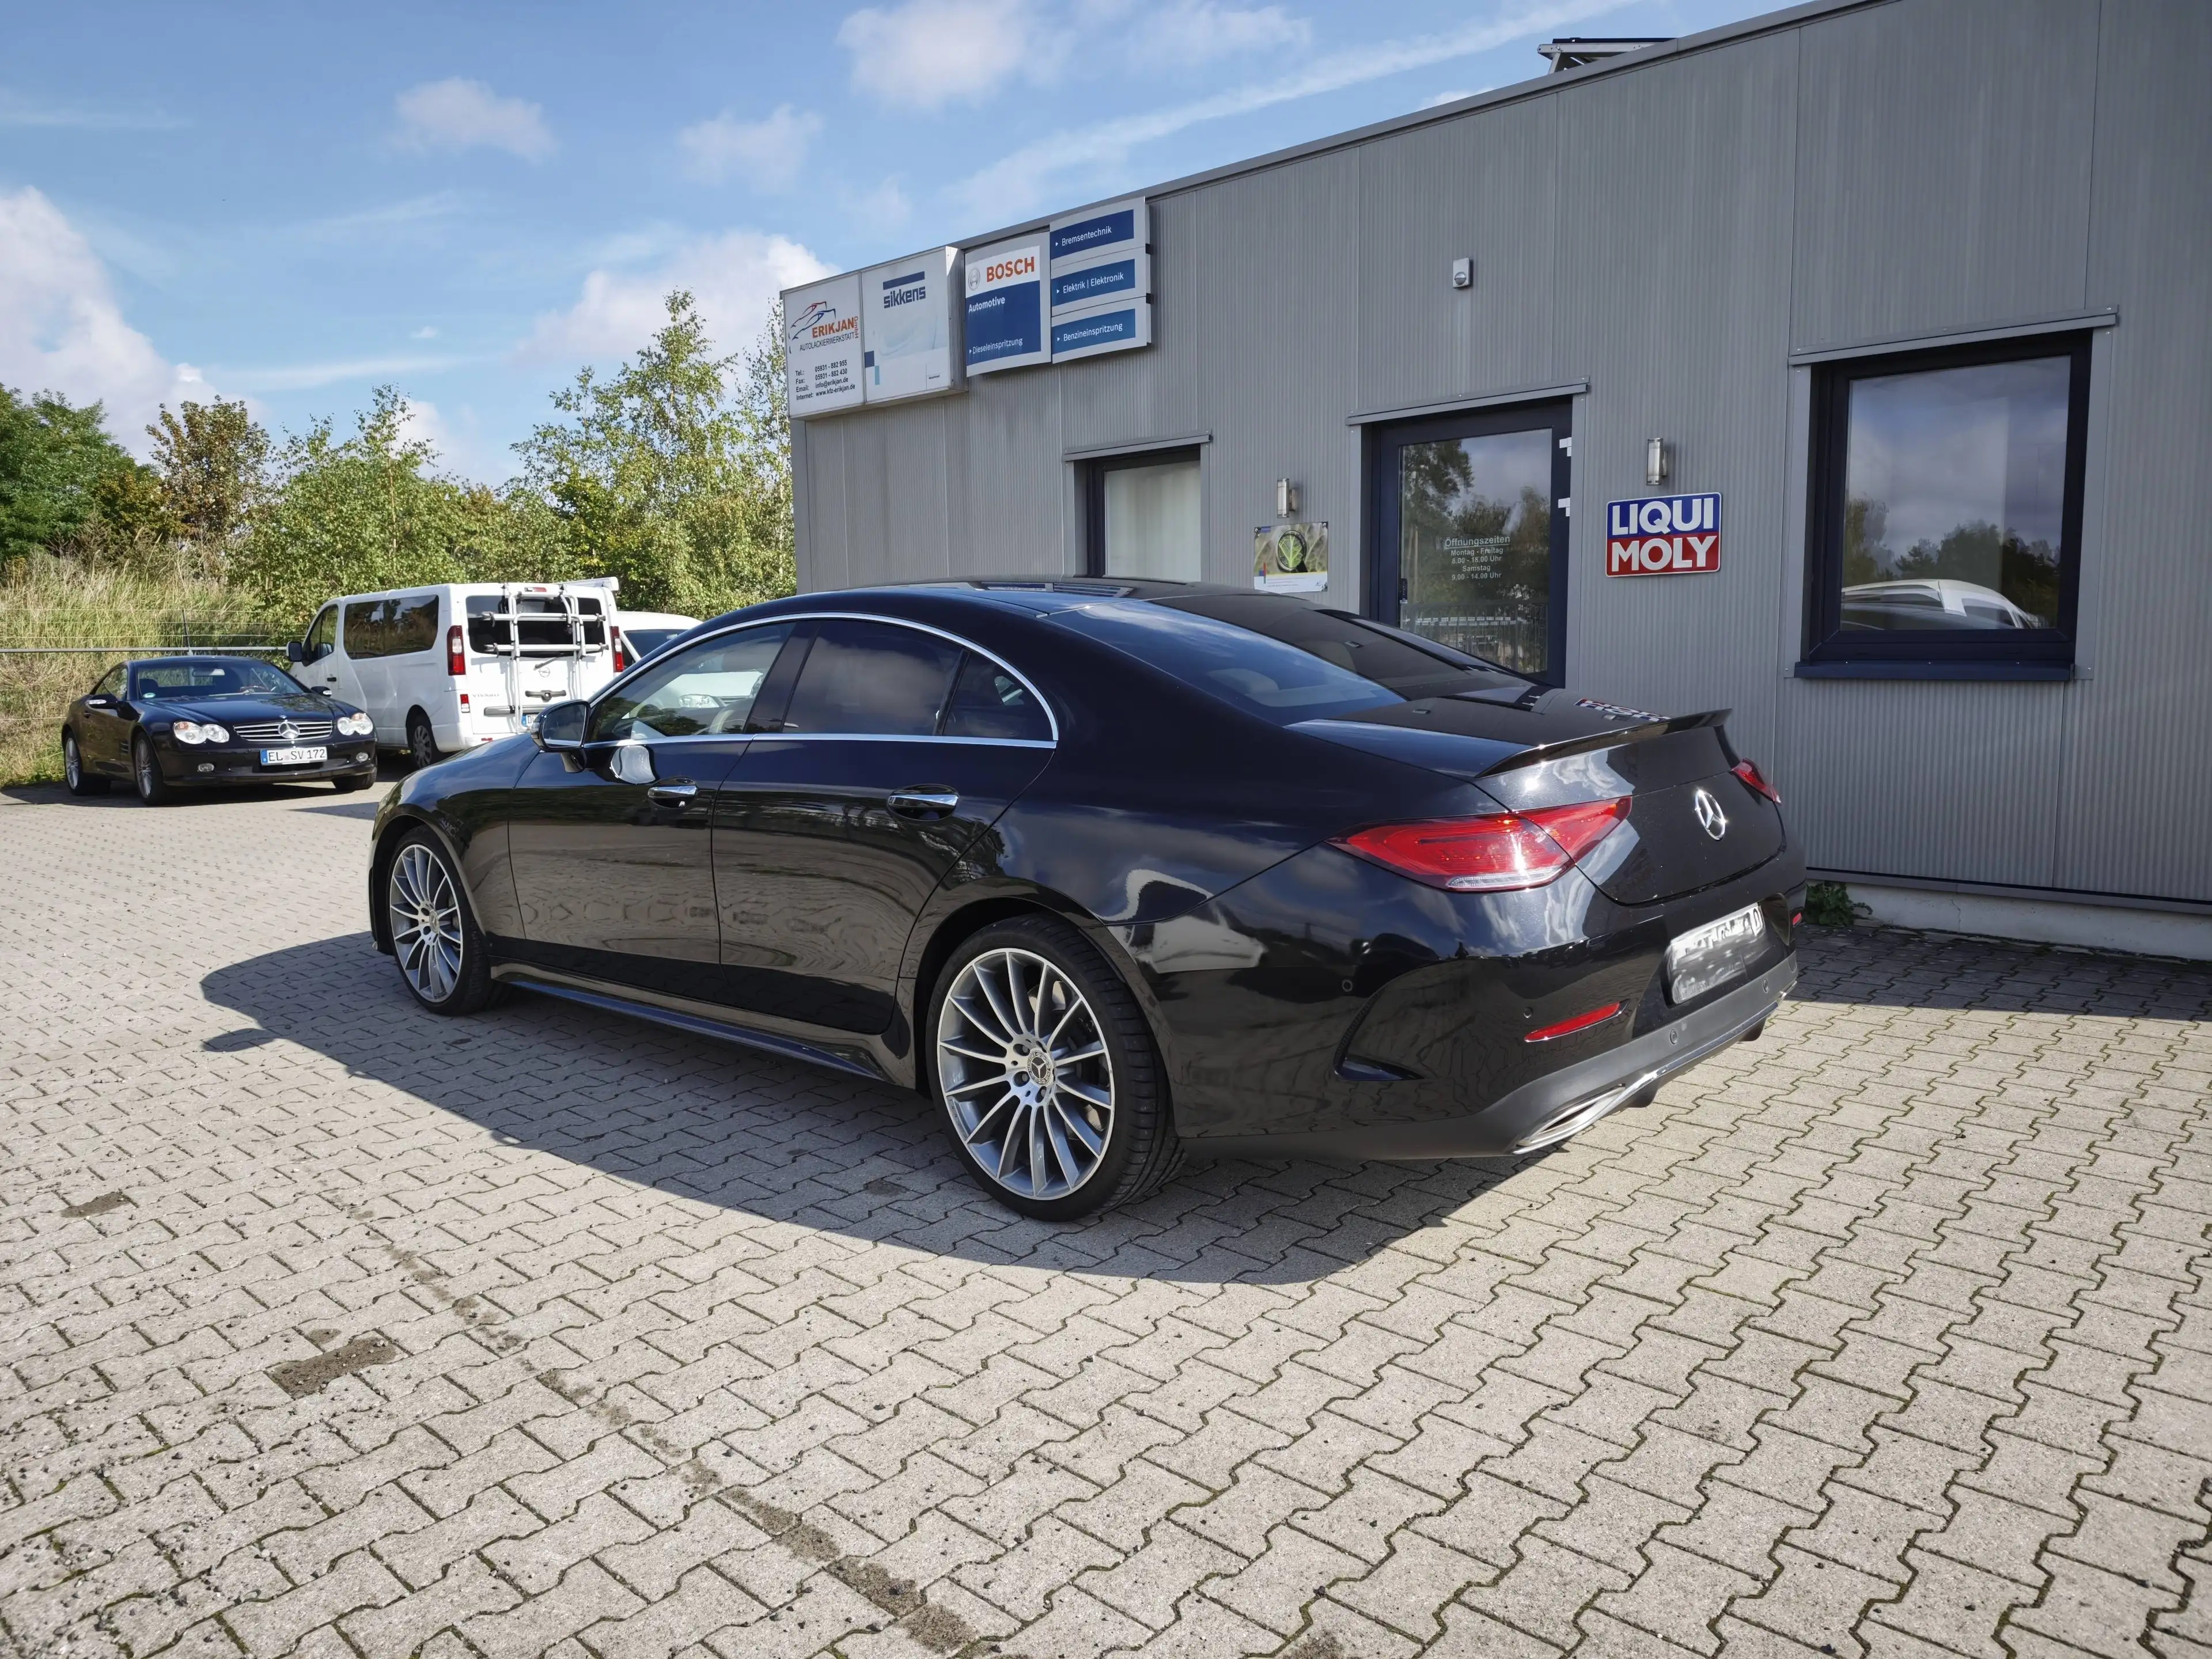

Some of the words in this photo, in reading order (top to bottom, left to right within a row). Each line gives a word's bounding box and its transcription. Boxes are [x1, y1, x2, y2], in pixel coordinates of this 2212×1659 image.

[1062, 226, 1112, 246] Bremsentechnik
[987, 256, 1035, 282] BOSCH
[1063, 281, 1085, 294] Elektrik
[1090, 272, 1124, 287] Elektronik
[884, 286, 926, 309] sikkens
[968, 296, 1005, 313] Automotive
[812, 317, 854, 338] ERIKJAN
[1063, 323, 1123, 342] Benzineinspritzung
[800, 332, 854, 351] AUTOLACKIERWERKSTATT
[972, 336, 1023, 354] Dieseleinspritzung
[815, 377, 848, 388] info@erikjan.de
[816, 384, 855, 396] www.kfz-erikjan.de
[1612, 498, 1714, 535] LIQUI
[1445, 536, 1510, 547] Öffnungszeiten
[1612, 536, 1718, 572] MOLY
[269, 752, 283, 761] EL
[291, 751, 304, 760] SV
[307, 749, 325, 759] 172
